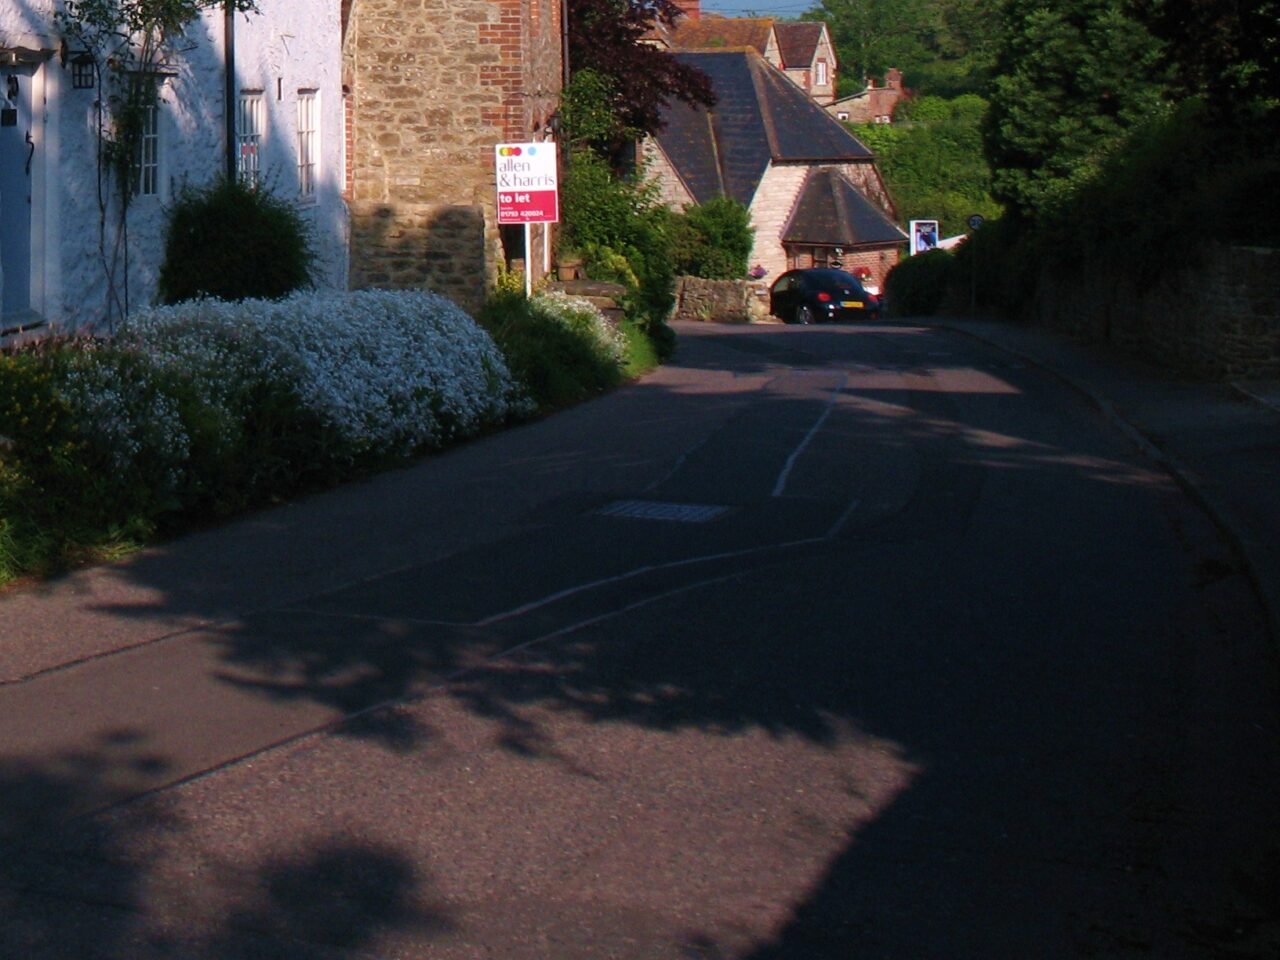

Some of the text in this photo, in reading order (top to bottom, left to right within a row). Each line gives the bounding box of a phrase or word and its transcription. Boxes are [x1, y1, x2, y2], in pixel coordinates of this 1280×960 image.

[499, 158, 530, 172] allen
[499, 173, 555, 187] & harris
[500, 192, 531, 203] to let
